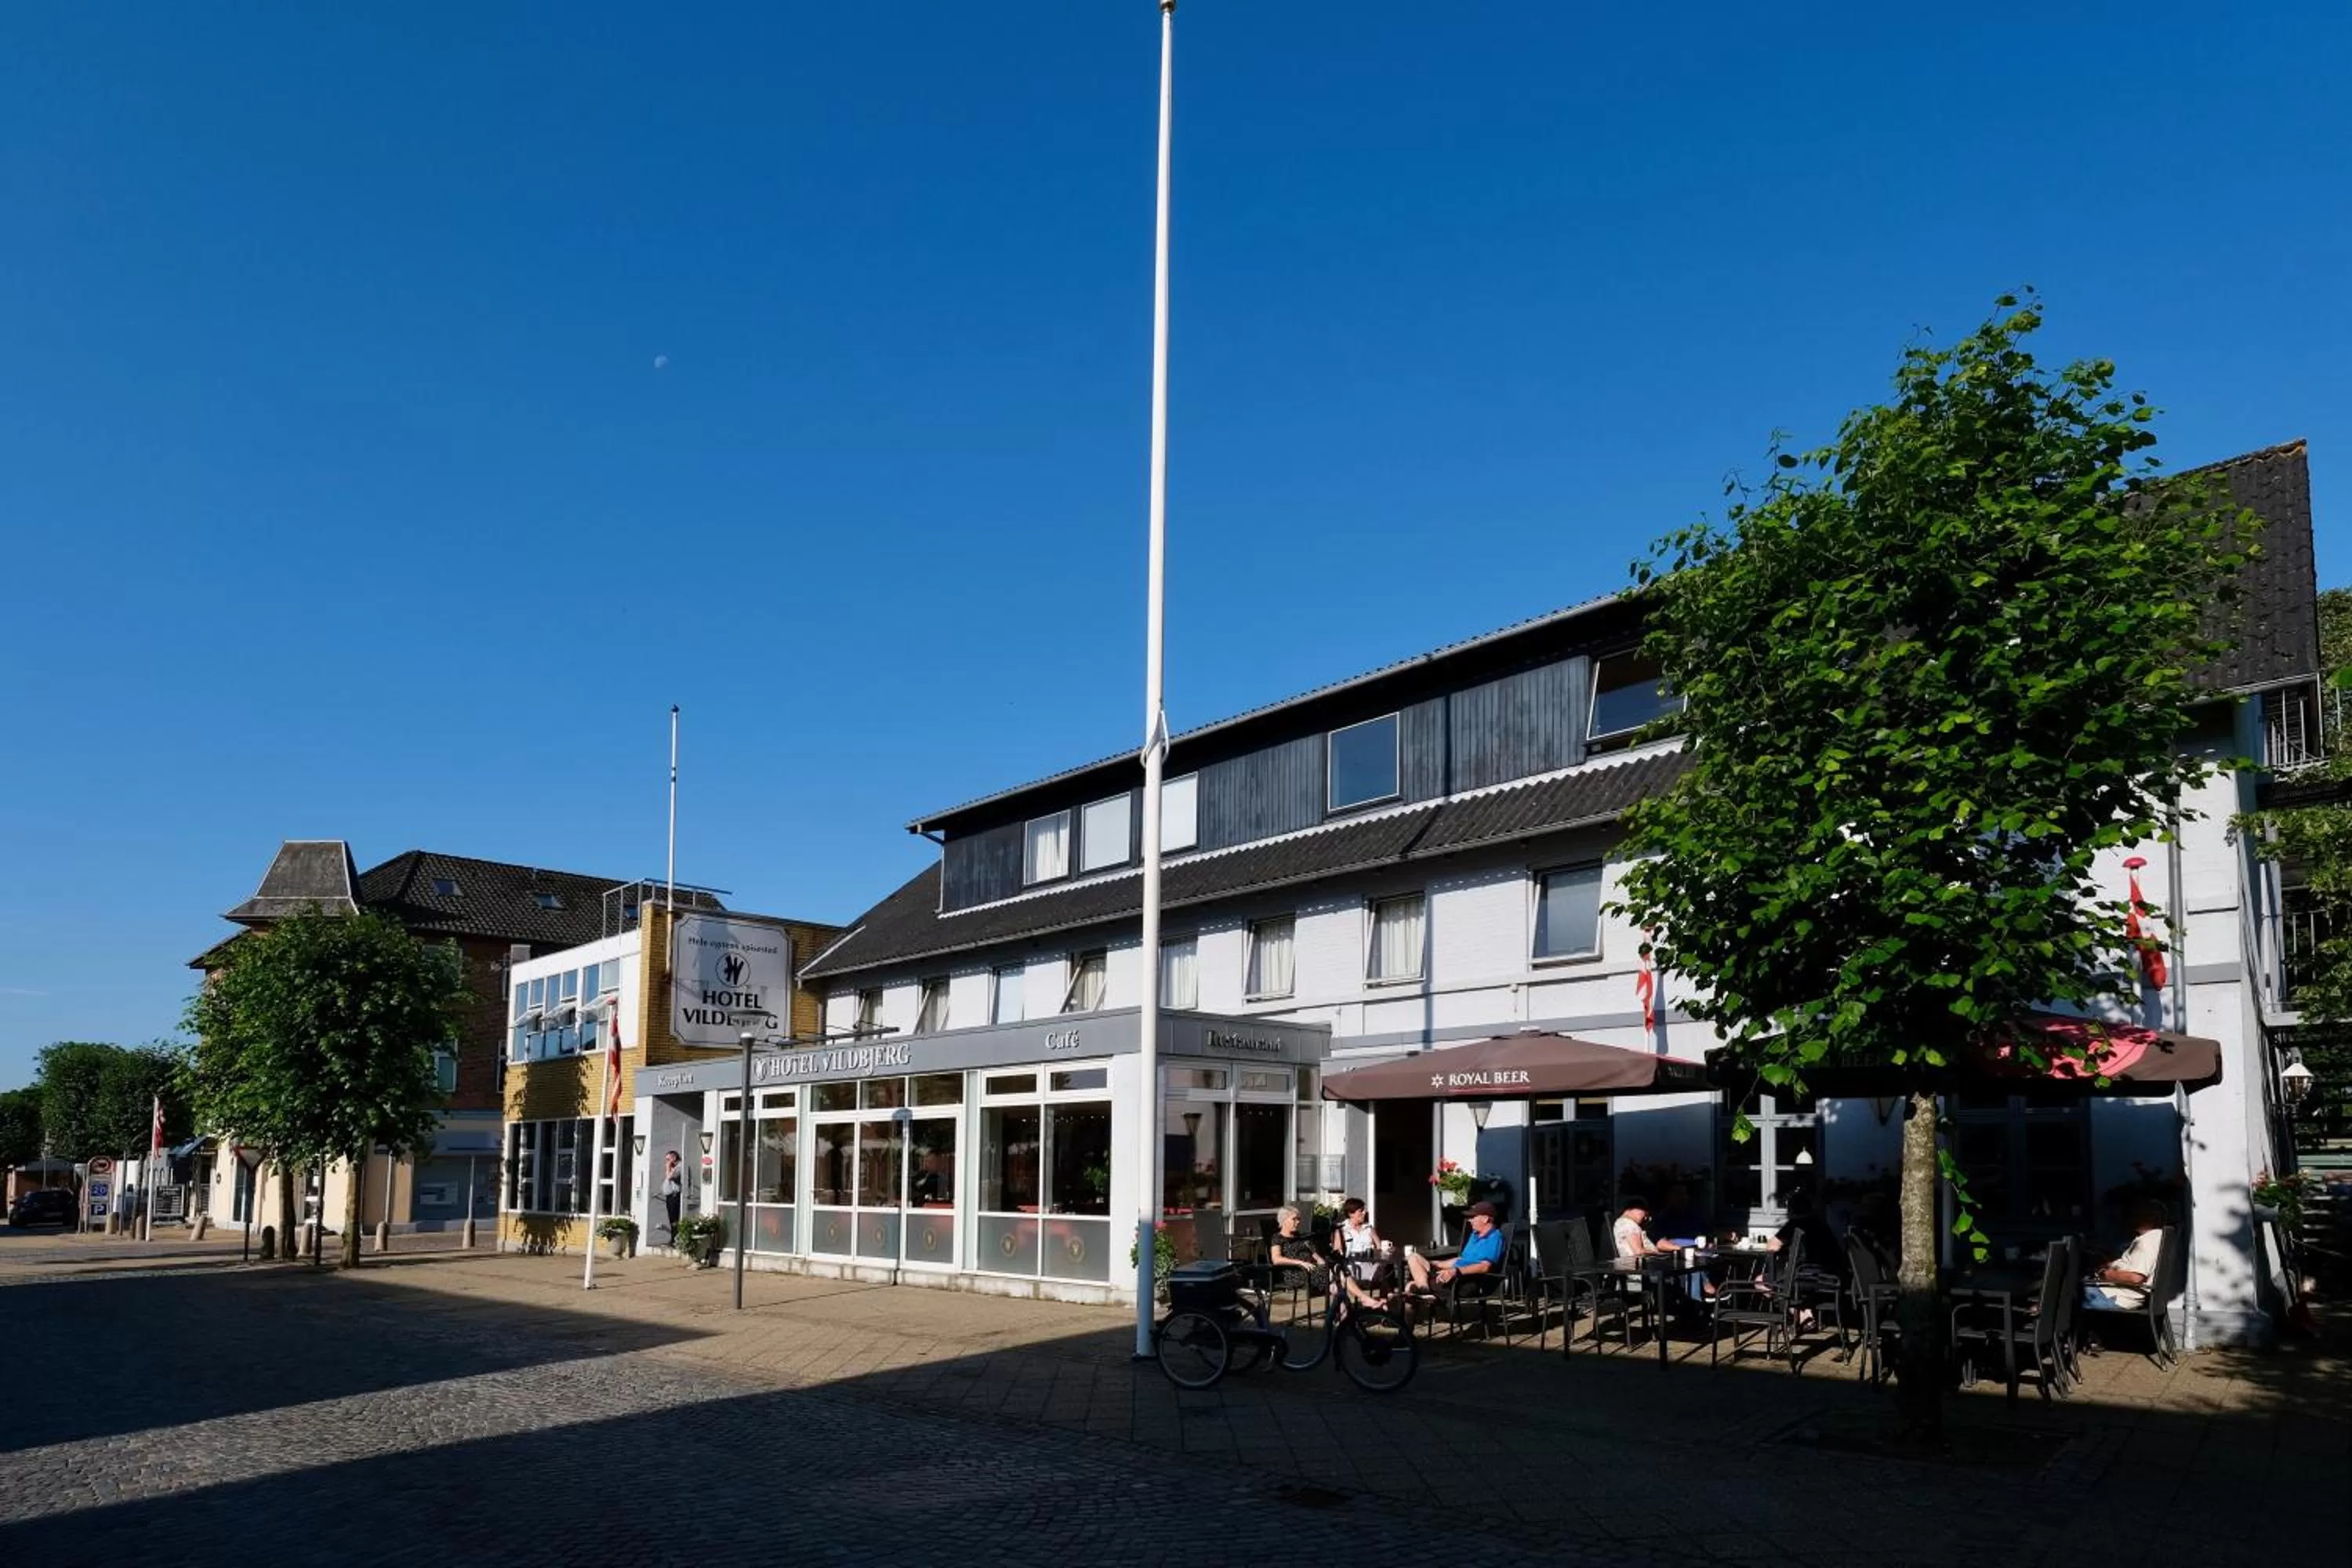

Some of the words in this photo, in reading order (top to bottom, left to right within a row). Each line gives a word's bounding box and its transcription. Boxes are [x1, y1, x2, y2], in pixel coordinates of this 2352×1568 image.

[702, 990, 763, 1009] HOTEL
[683, 1007, 778, 1029] VILDG
[1046, 1029, 1079, 1049] Café
[771, 1054, 818, 1077] HOTEL
[823, 1044, 911, 1074] VILDBJERG
[1449, 1071, 1491, 1087] ROYAL
[1494, 1069, 1530, 1083] BEER
[94, 1205, 104, 1214] P
